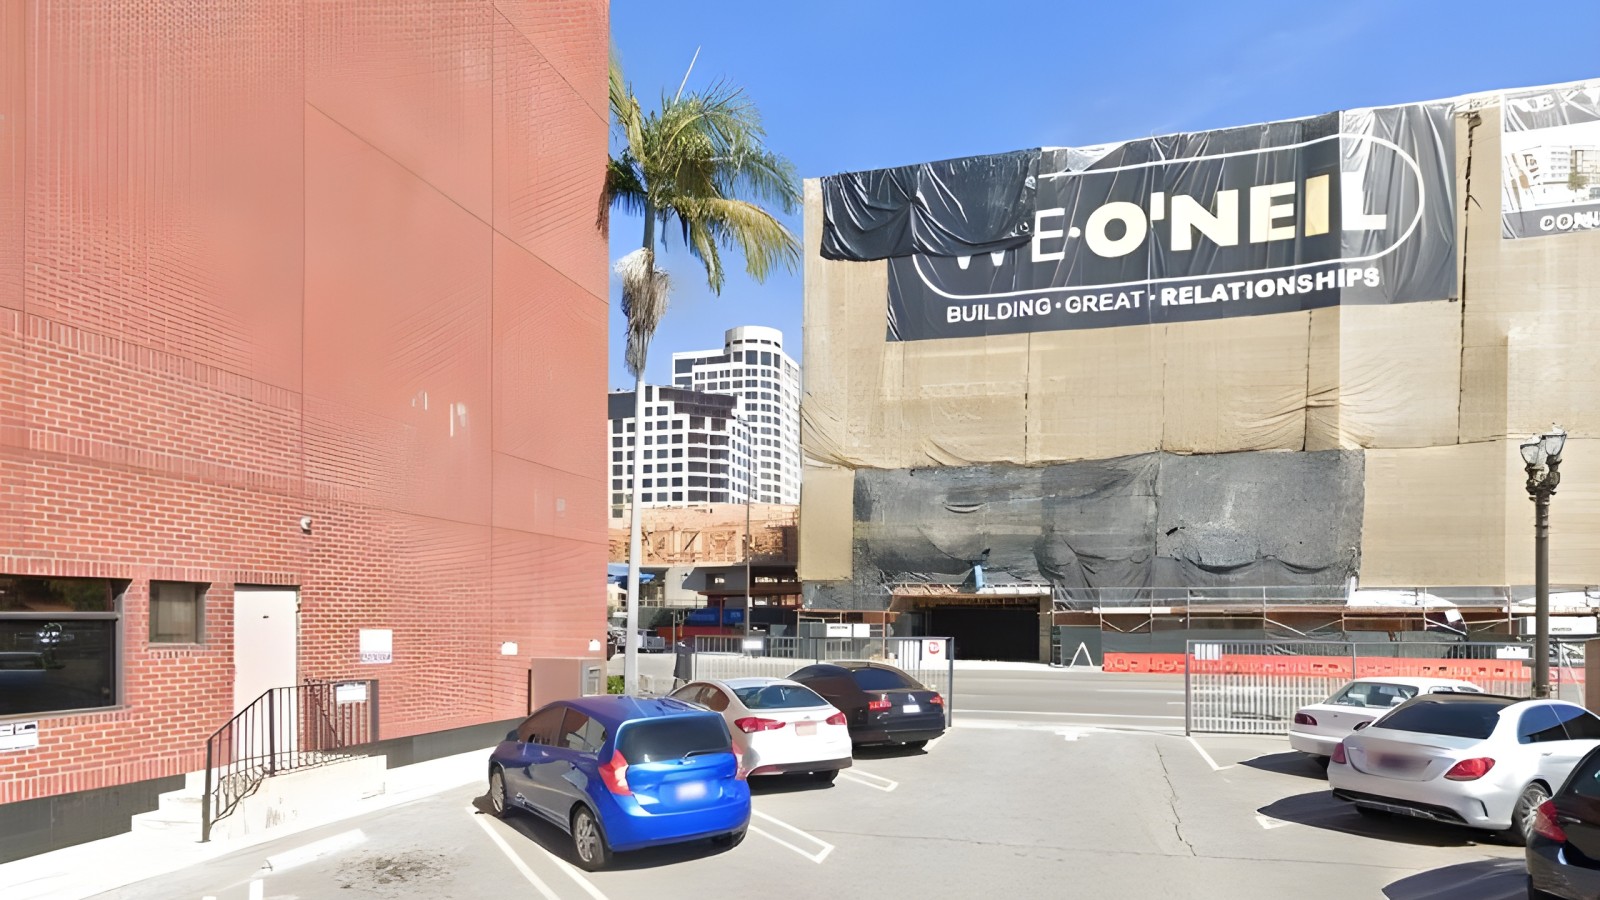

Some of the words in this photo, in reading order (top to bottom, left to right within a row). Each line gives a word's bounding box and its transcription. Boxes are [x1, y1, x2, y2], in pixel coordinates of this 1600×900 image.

[946, 297, 1051, 323] BUILDING
[1065, 290, 1145, 313] GREAT
[1161, 268, 1381, 306] RELATIONSHIPS
